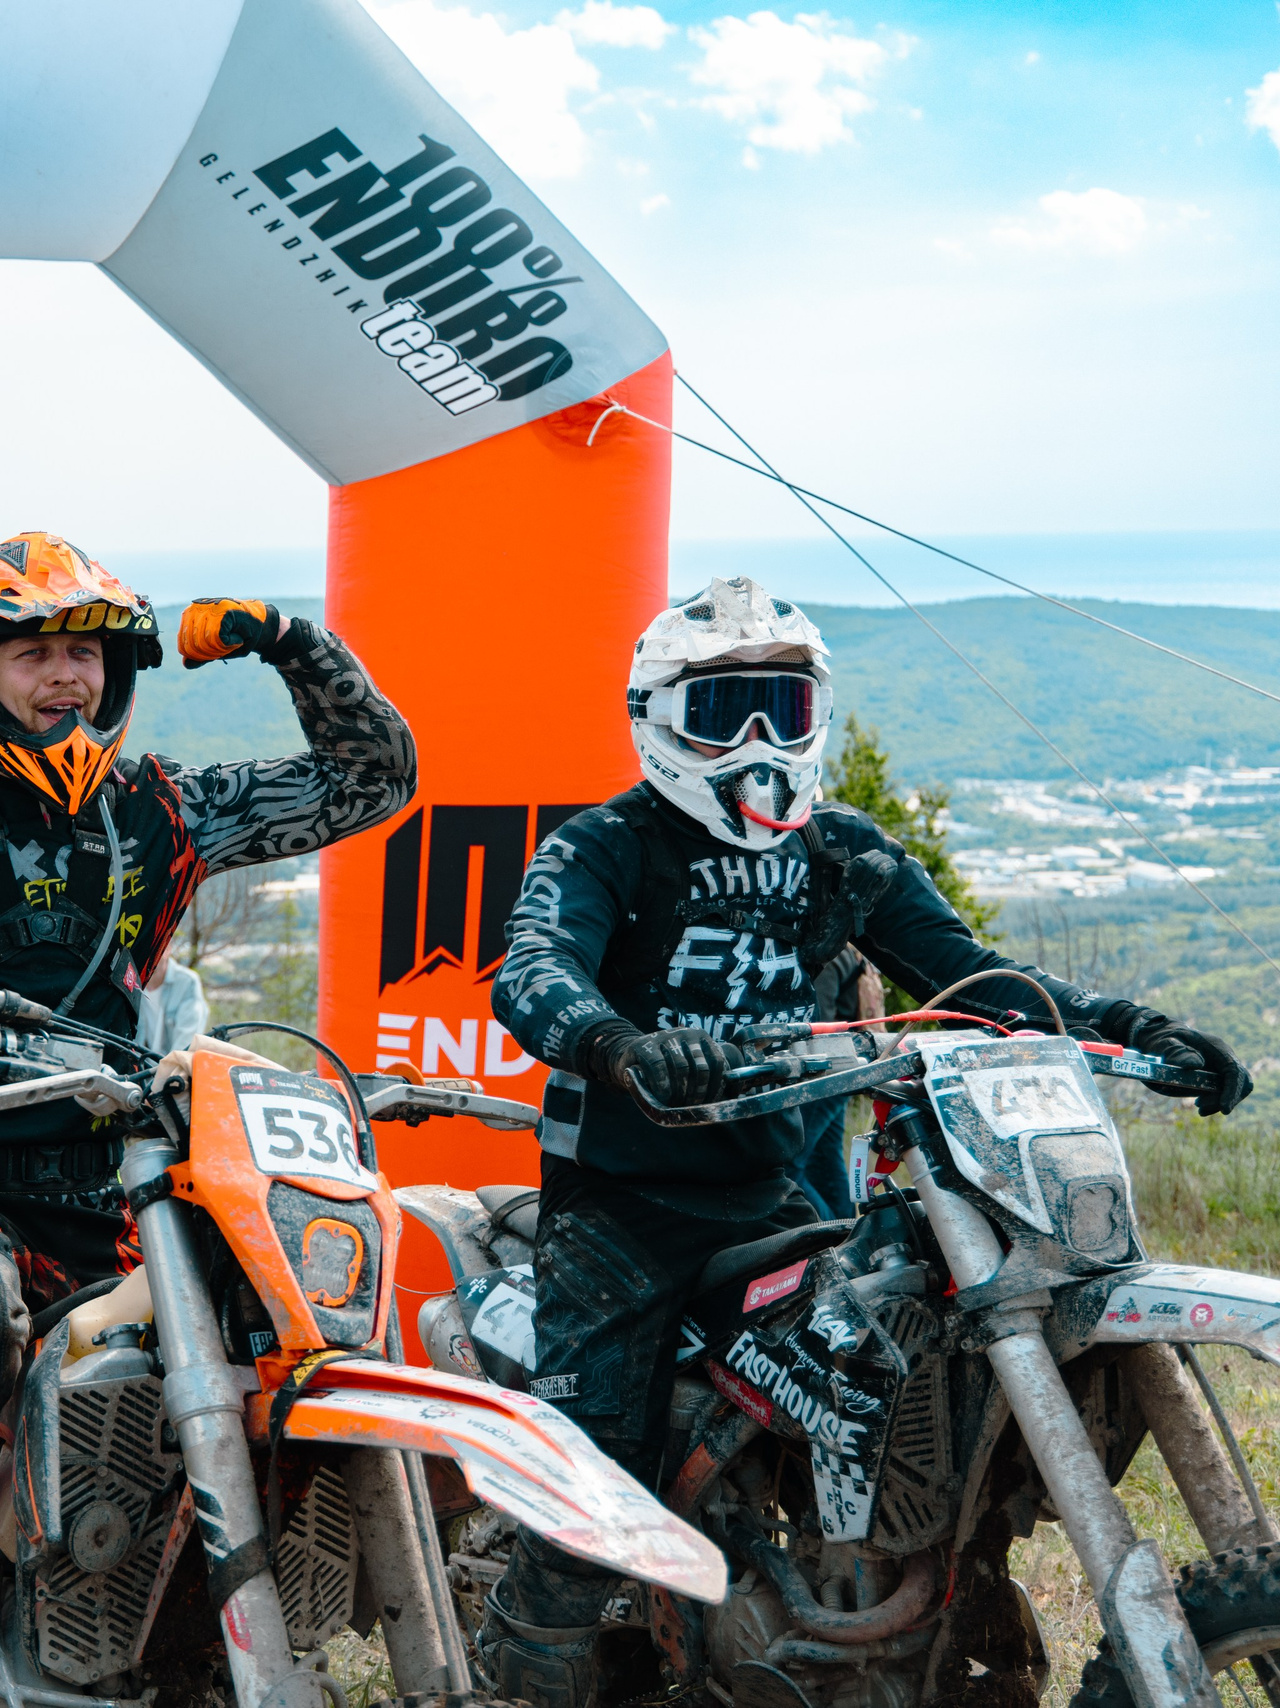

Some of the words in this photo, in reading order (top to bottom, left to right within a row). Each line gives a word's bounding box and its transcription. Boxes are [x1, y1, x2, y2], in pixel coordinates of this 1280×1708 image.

[199, 152, 368, 314] GELENDZHIK
[252, 127, 573, 401] ENDURO
[360, 297, 501, 417] team
[641, 744, 680, 783] LS2
[376, 1012, 540, 1078] END
[542, 1023, 565, 1060] THE
[557, 999, 602, 1026] FAST
[1130, 1062, 1150, 1075] Fast
[261, 1106, 361, 1177] 536
[854, 1168, 862, 1200] ENDURO
[761, 1275, 798, 1298] TAKAYAMA
[1148, 1302, 1184, 1316] KTM
[725, 1330, 868, 1457] FASTHOUSE
[784, 1330, 827, 1376] Husqvarna
[826, 1365, 887, 1419] Racing
[466, 1418, 521, 1447] VELOCITY
